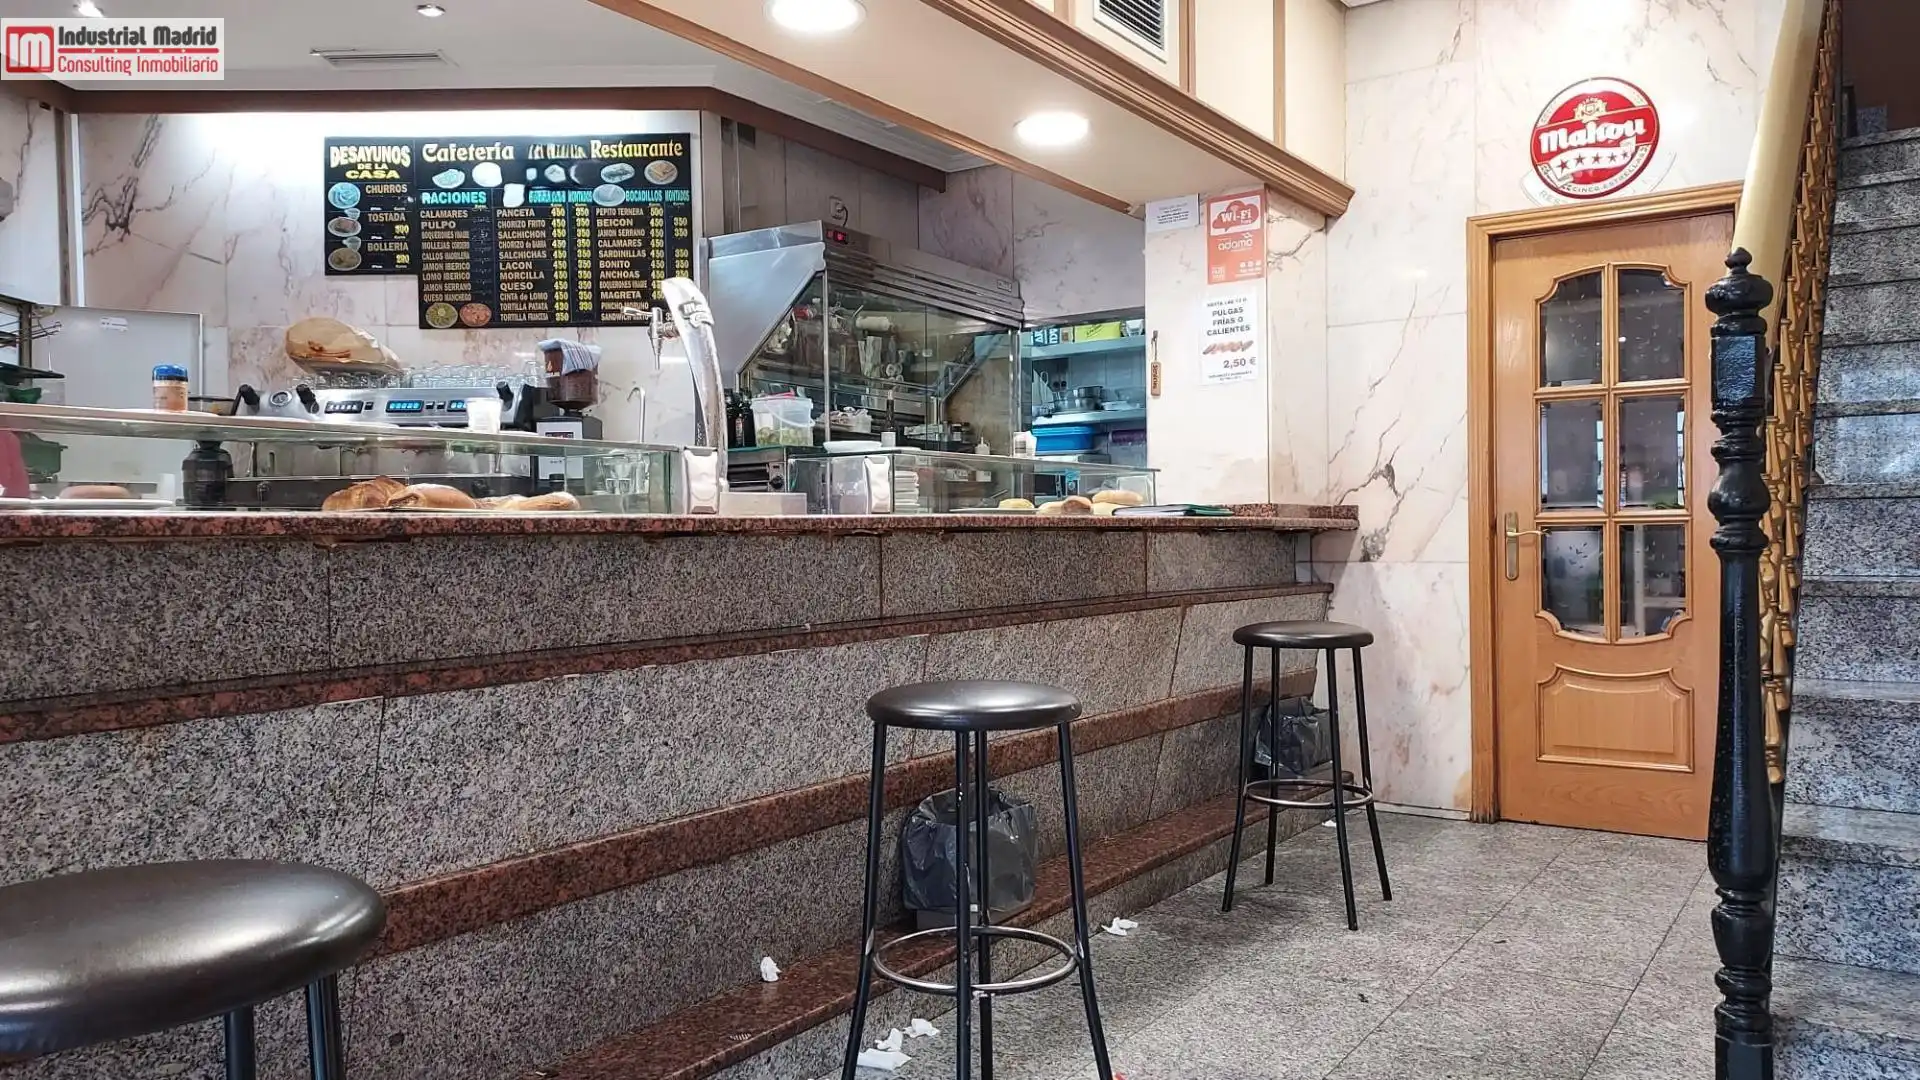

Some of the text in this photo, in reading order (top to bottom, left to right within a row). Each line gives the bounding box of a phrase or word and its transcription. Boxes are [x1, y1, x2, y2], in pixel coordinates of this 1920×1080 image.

[1539, 119, 1647, 154] Mahou
[422, 142, 515, 162] Cafetería
[590, 140, 683, 158] Restaurante
[330, 146, 411, 168] DESAYUNOS
[346, 170, 400, 179] CASA
[366, 184, 408, 193] CHURROS
[422, 191, 486, 204] RACIONES
[626, 190, 662, 202] BOCADILLOS
[420, 210, 468, 218] CALAMARES
[496, 208, 535, 217] PANCETA
[596, 208, 616, 216] PEPITO
[618, 208, 644, 216] TERNERA
[368, 213, 406, 222] TOSTADA
[421, 221, 456, 229] PULPO
[498, 220, 526, 228] CHORIZO
[528, 220, 545, 228] FRITO
[498, 231, 546, 239] SALCHICHON
[598, 229, 617, 237] JAMON
[368, 242, 408, 252] BOLLERIA
[499, 241, 524, 249] CHORIZO
[598, 239, 642, 247] CALAMARES
[1218, 238, 1253, 251] adamo
[422, 252, 443, 260] CALLOS
[499, 251, 547, 259] SALCHICHAS
[599, 250, 646, 258] SARDINILLAS
[422, 262, 470, 271] JAMON IBERICO
[500, 262, 532, 270] LACON
[422, 272, 470, 280] LOMO IBERICO
[500, 271, 545, 280] MORCILLA
[600, 271, 640, 279] ANCHOAS
[444, 283, 472, 291] SERRANO
[500, 282, 533, 291] QUESO
[424, 294, 443, 302] QUESO
[500, 293, 518, 301] CINTA
[530, 292, 548, 300] LOMO
[600, 291, 642, 299] MAGRETA
[1212, 307, 1244, 317] PULGAS
[1212, 317, 1236, 326] FRÍAS
[1206, 324, 1250, 336] CALIENTES
[1223, 357, 1256, 369] 2,50 €
